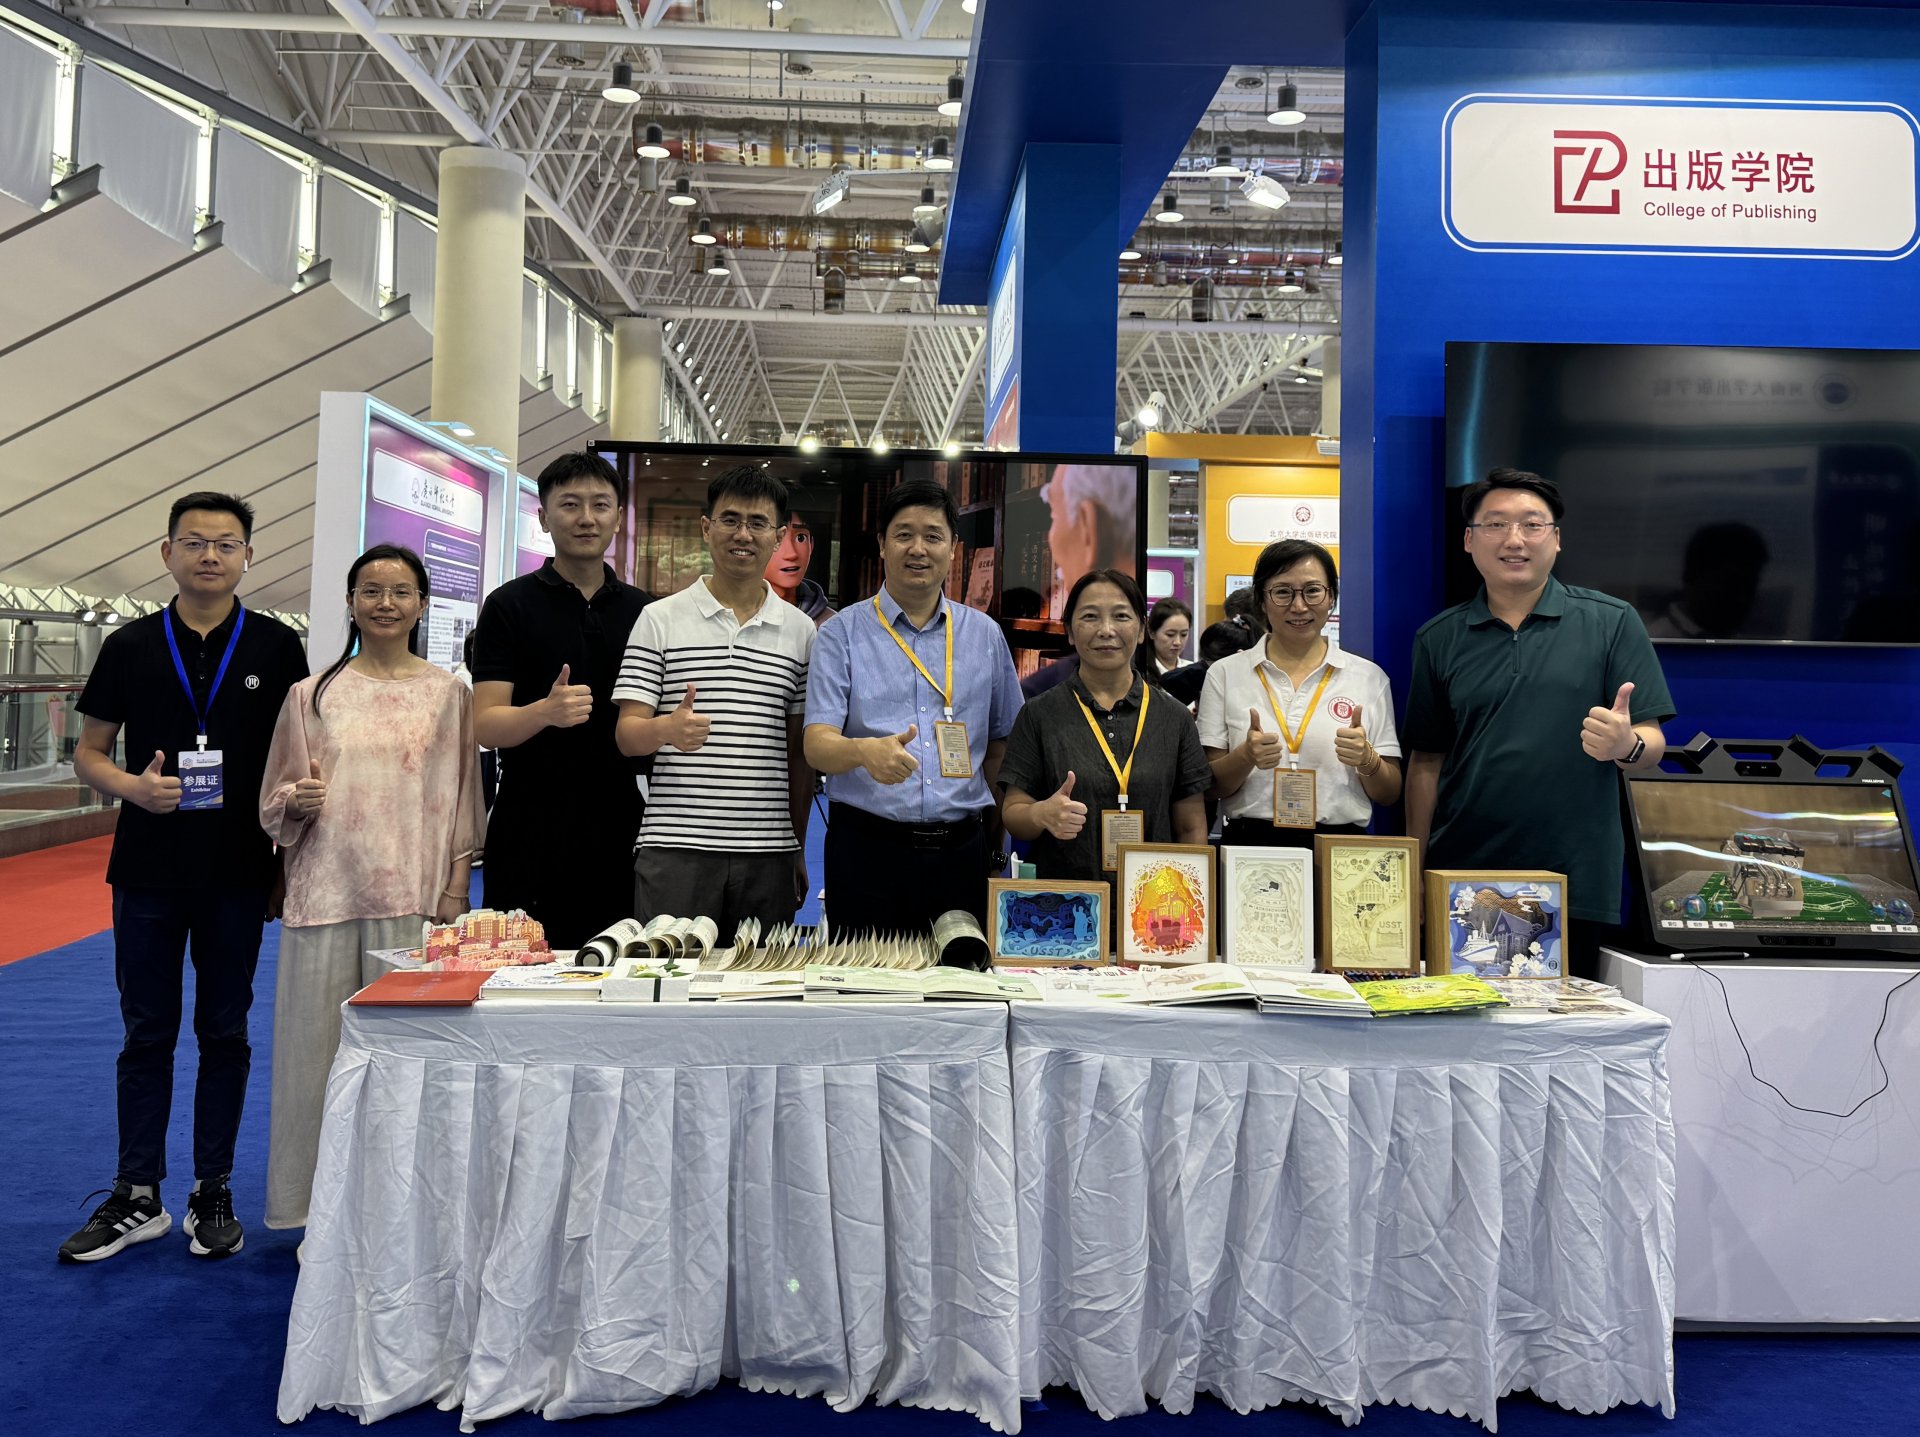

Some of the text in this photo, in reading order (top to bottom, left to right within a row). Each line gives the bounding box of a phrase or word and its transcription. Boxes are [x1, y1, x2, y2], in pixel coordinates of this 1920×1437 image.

[1642, 148, 1816, 194] 出版学院
[1643, 201, 1818, 223] College of Publishing
[183, 774, 219, 787] 参展证
[1379, 921, 1403, 929] USST
[1030, 946, 1064, 957] USST
